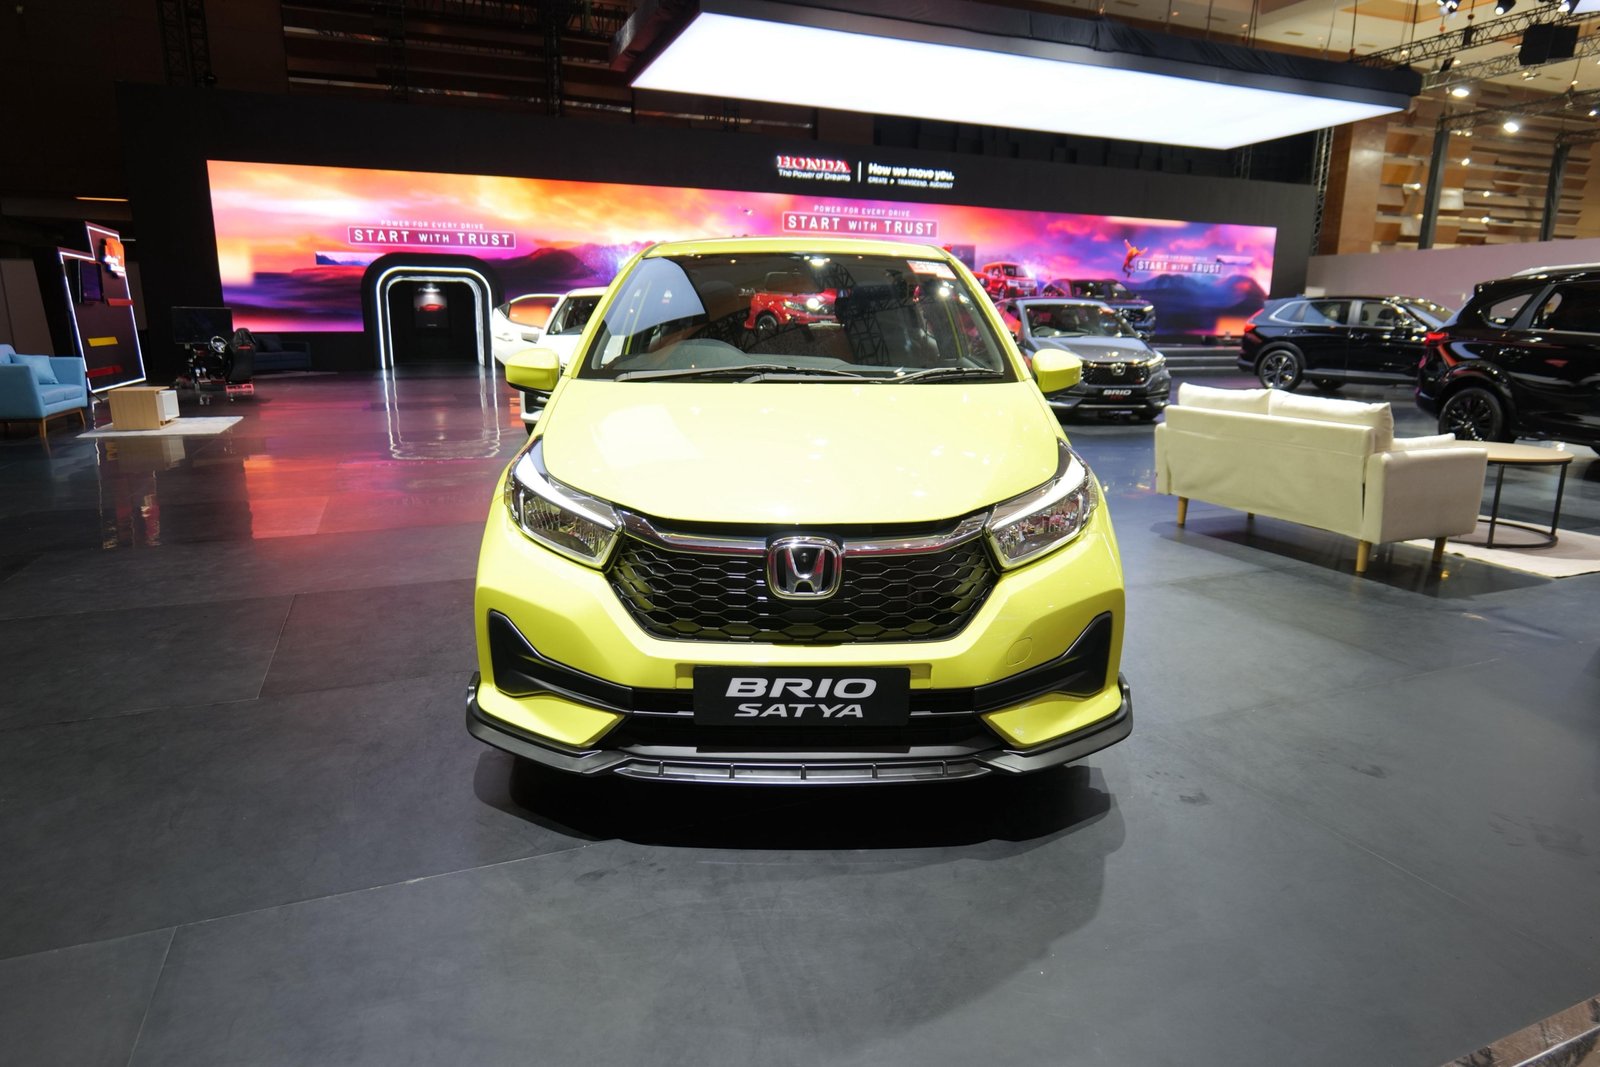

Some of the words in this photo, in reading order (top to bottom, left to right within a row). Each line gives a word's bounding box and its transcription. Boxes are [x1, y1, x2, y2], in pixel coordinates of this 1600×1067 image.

[777, 155, 851, 173] HONDA
[868, 162, 892, 177] How
[908, 168, 934, 180] move
[779, 169, 792, 177] The
[793, 170, 815, 178] Power
[824, 172, 851, 182] Dreams
[814, 205, 841, 213] POWER
[380, 219, 409, 227] POWER
[413, 220, 428, 228] FOR
[788, 215, 840, 230] START
[848, 220, 878, 231] WITH
[885, 220, 933, 235] TRUST
[354, 229, 409, 243] START
[418, 233, 450, 243] WITH
[457, 232, 510, 246] TRUST
[1138, 260, 1168, 271] START
[1192, 263, 1220, 274] TRUST
[725, 677, 877, 699] BRIO
[734, 703, 864, 718] SATYA
